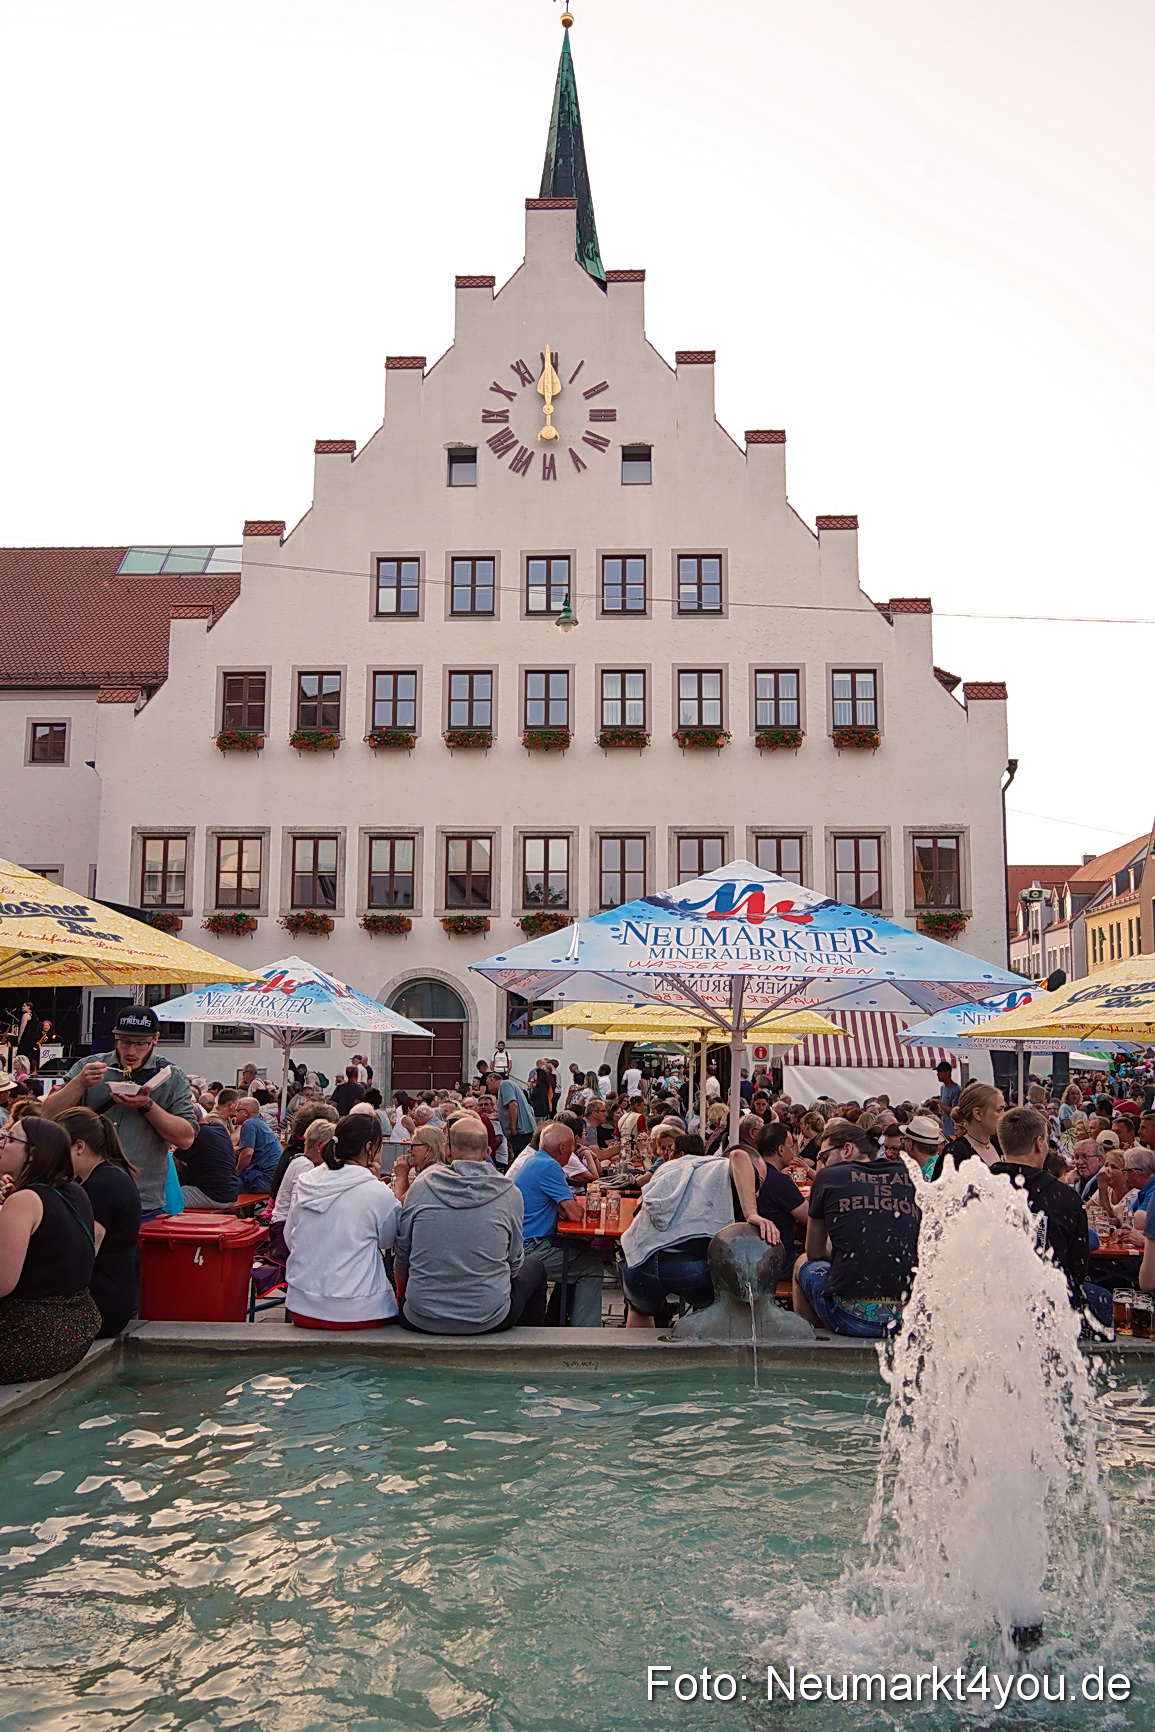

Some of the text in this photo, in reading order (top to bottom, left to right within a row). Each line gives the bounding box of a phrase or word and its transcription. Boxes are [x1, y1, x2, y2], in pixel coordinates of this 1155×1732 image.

[57, 920, 125, 943] Bier
[619, 920, 882, 955] NEUMARKTER
[648, 947, 854, 966] MINERALBRUNNEN
[628, 960, 875, 976] WASSER ZUM LEBEN
[197, 991, 314, 1015] NEUMARKTER
[203, 1007, 293, 1020] MINERALBRUNNEN
[850, 1171, 913, 1187] METAL
[874, 1184, 893, 1197] IS
[838, 1195, 920, 1220] RELIGION
[193, 1246, 205, 1267] 4
